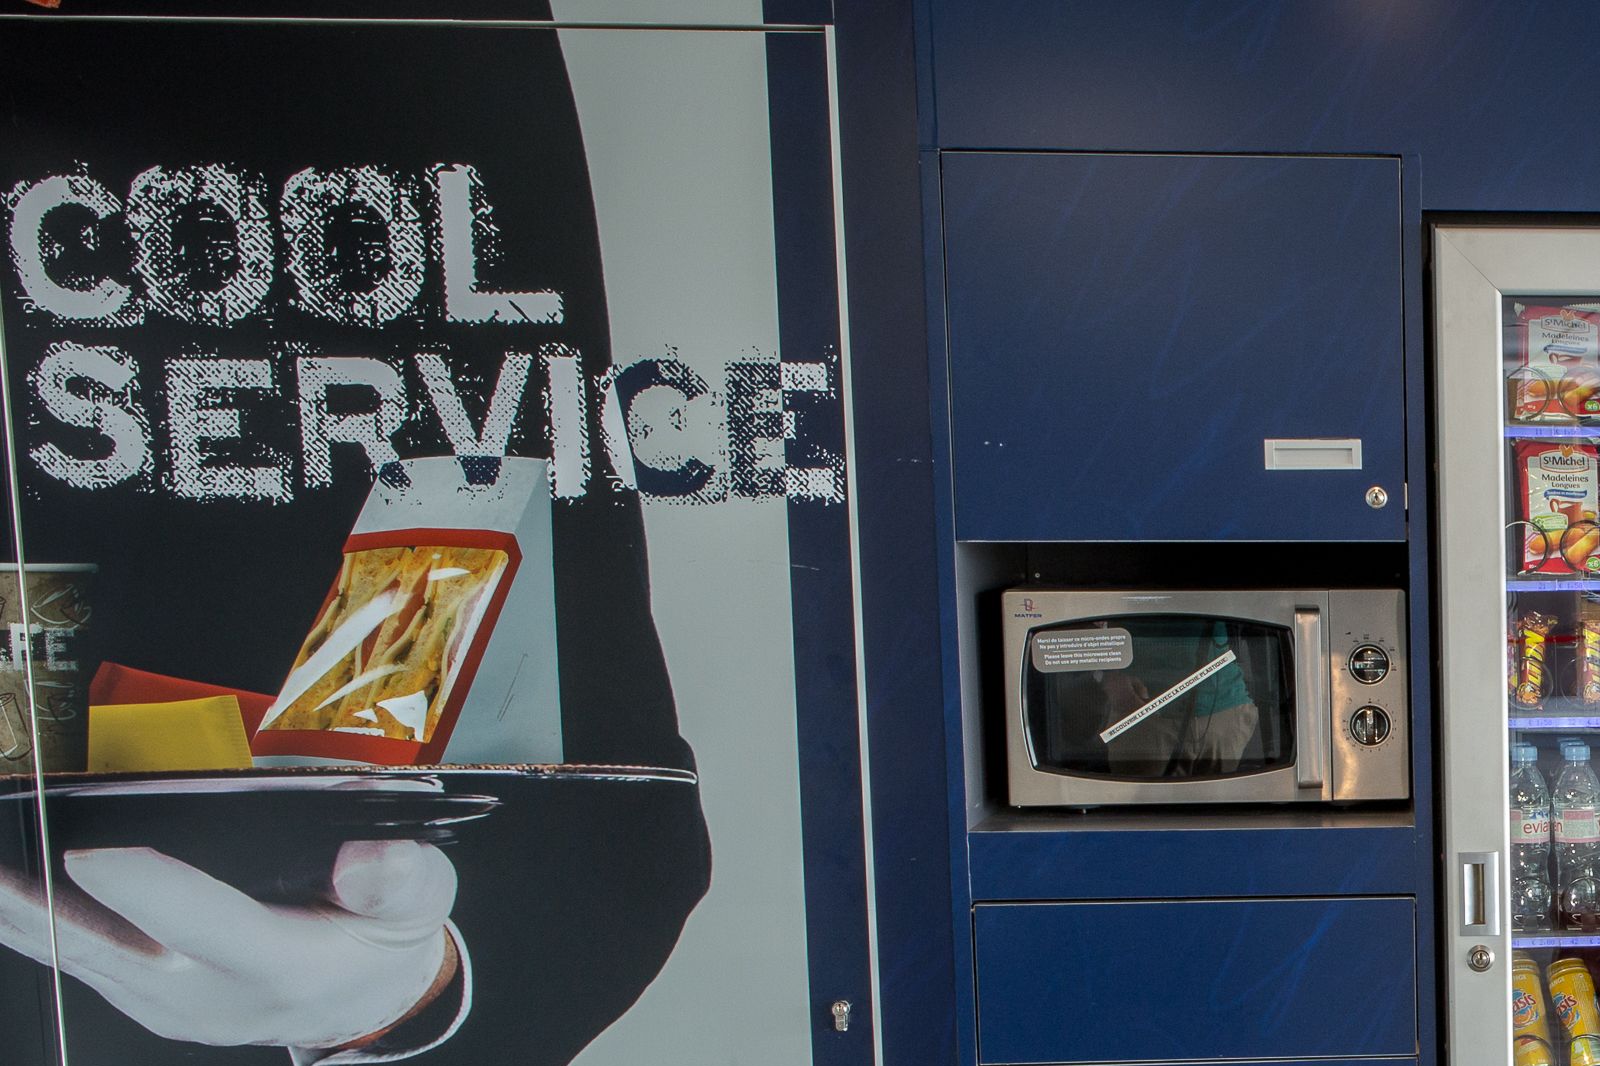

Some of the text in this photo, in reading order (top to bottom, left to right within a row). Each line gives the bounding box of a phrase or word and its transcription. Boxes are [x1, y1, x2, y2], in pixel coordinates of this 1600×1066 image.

[5, 163, 565, 329] COOL
[26, 341, 846, 506] SERVICE
[1541, 474, 1588, 483] Madeleines
[1552, 456, 1586, 467] Michel
[0, 622, 79, 672] FE
[1144, 657, 1227, 714] PLAT AVEC CLOCHE PLASTIQUE
[1523, 819, 1548, 834] evia
